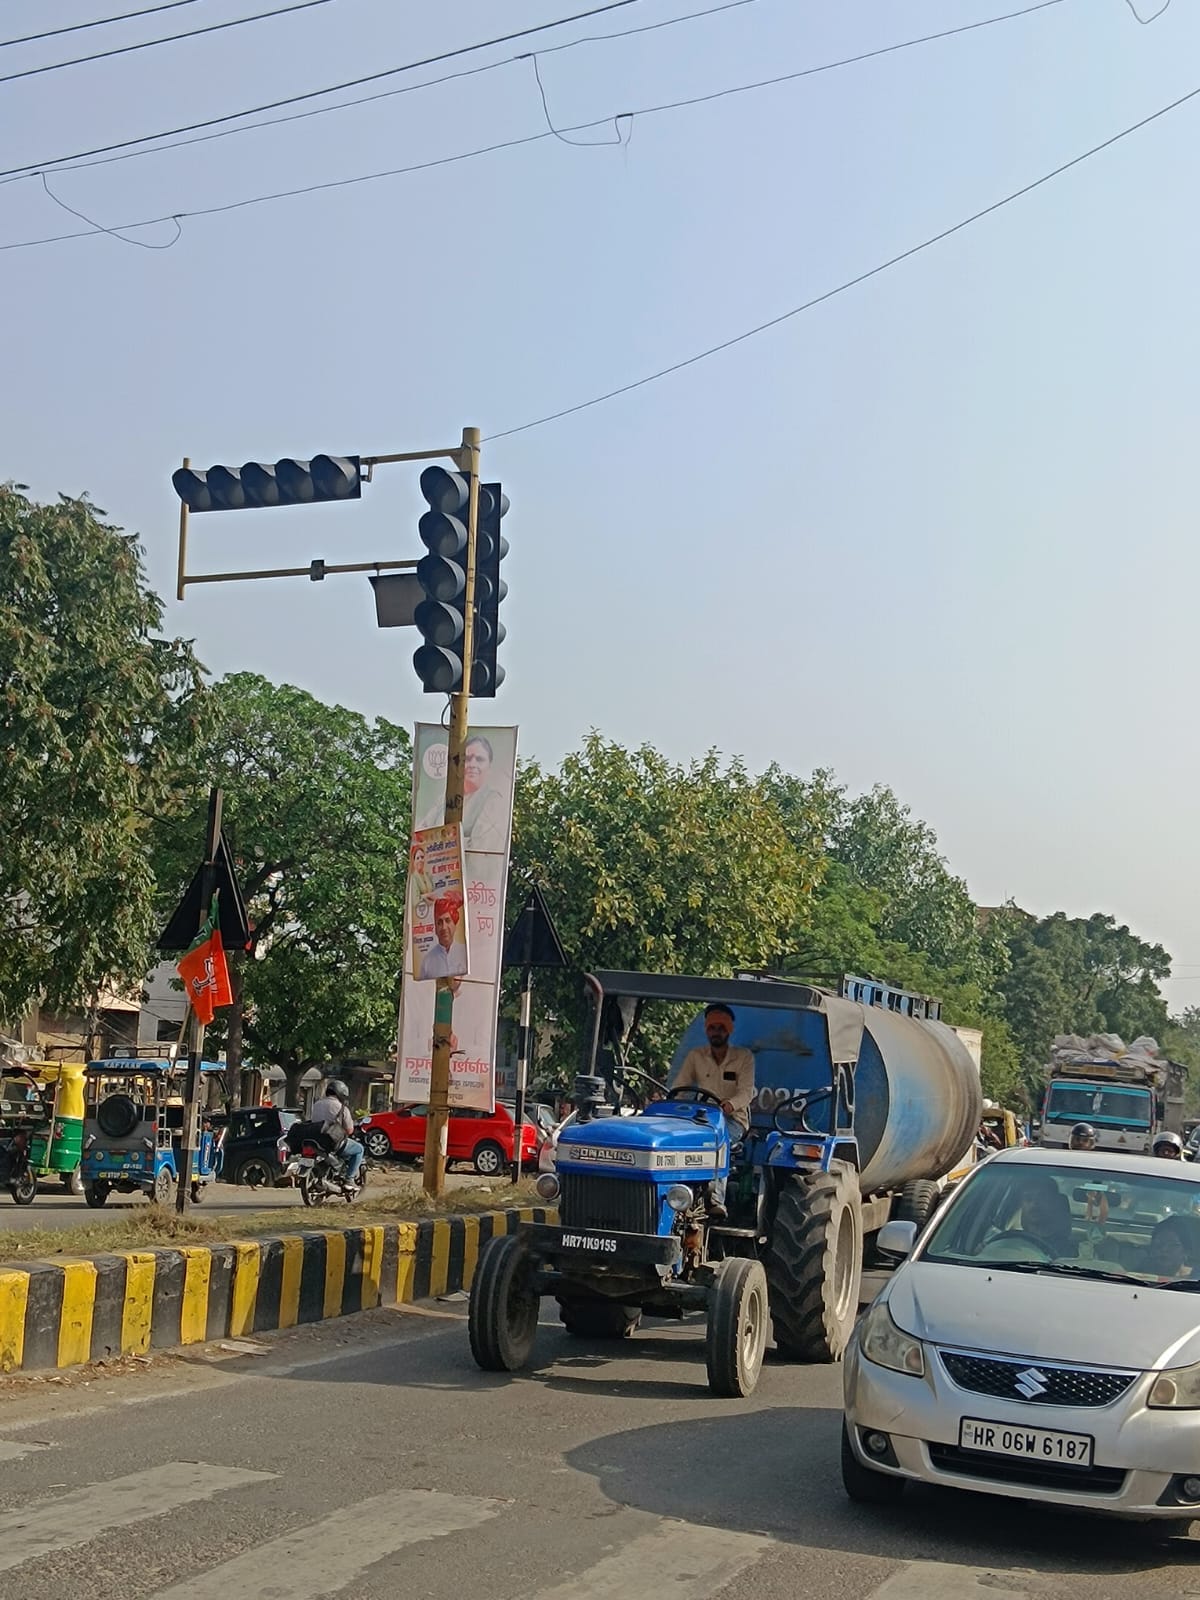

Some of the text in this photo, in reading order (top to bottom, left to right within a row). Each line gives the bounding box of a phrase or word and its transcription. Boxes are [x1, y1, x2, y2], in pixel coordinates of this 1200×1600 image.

[570, 1146, 635, 1165] SONALIKA
[562, 1235, 617, 1252] HR71K9155
[973, 1426, 1089, 1460] HR 06W 6187
